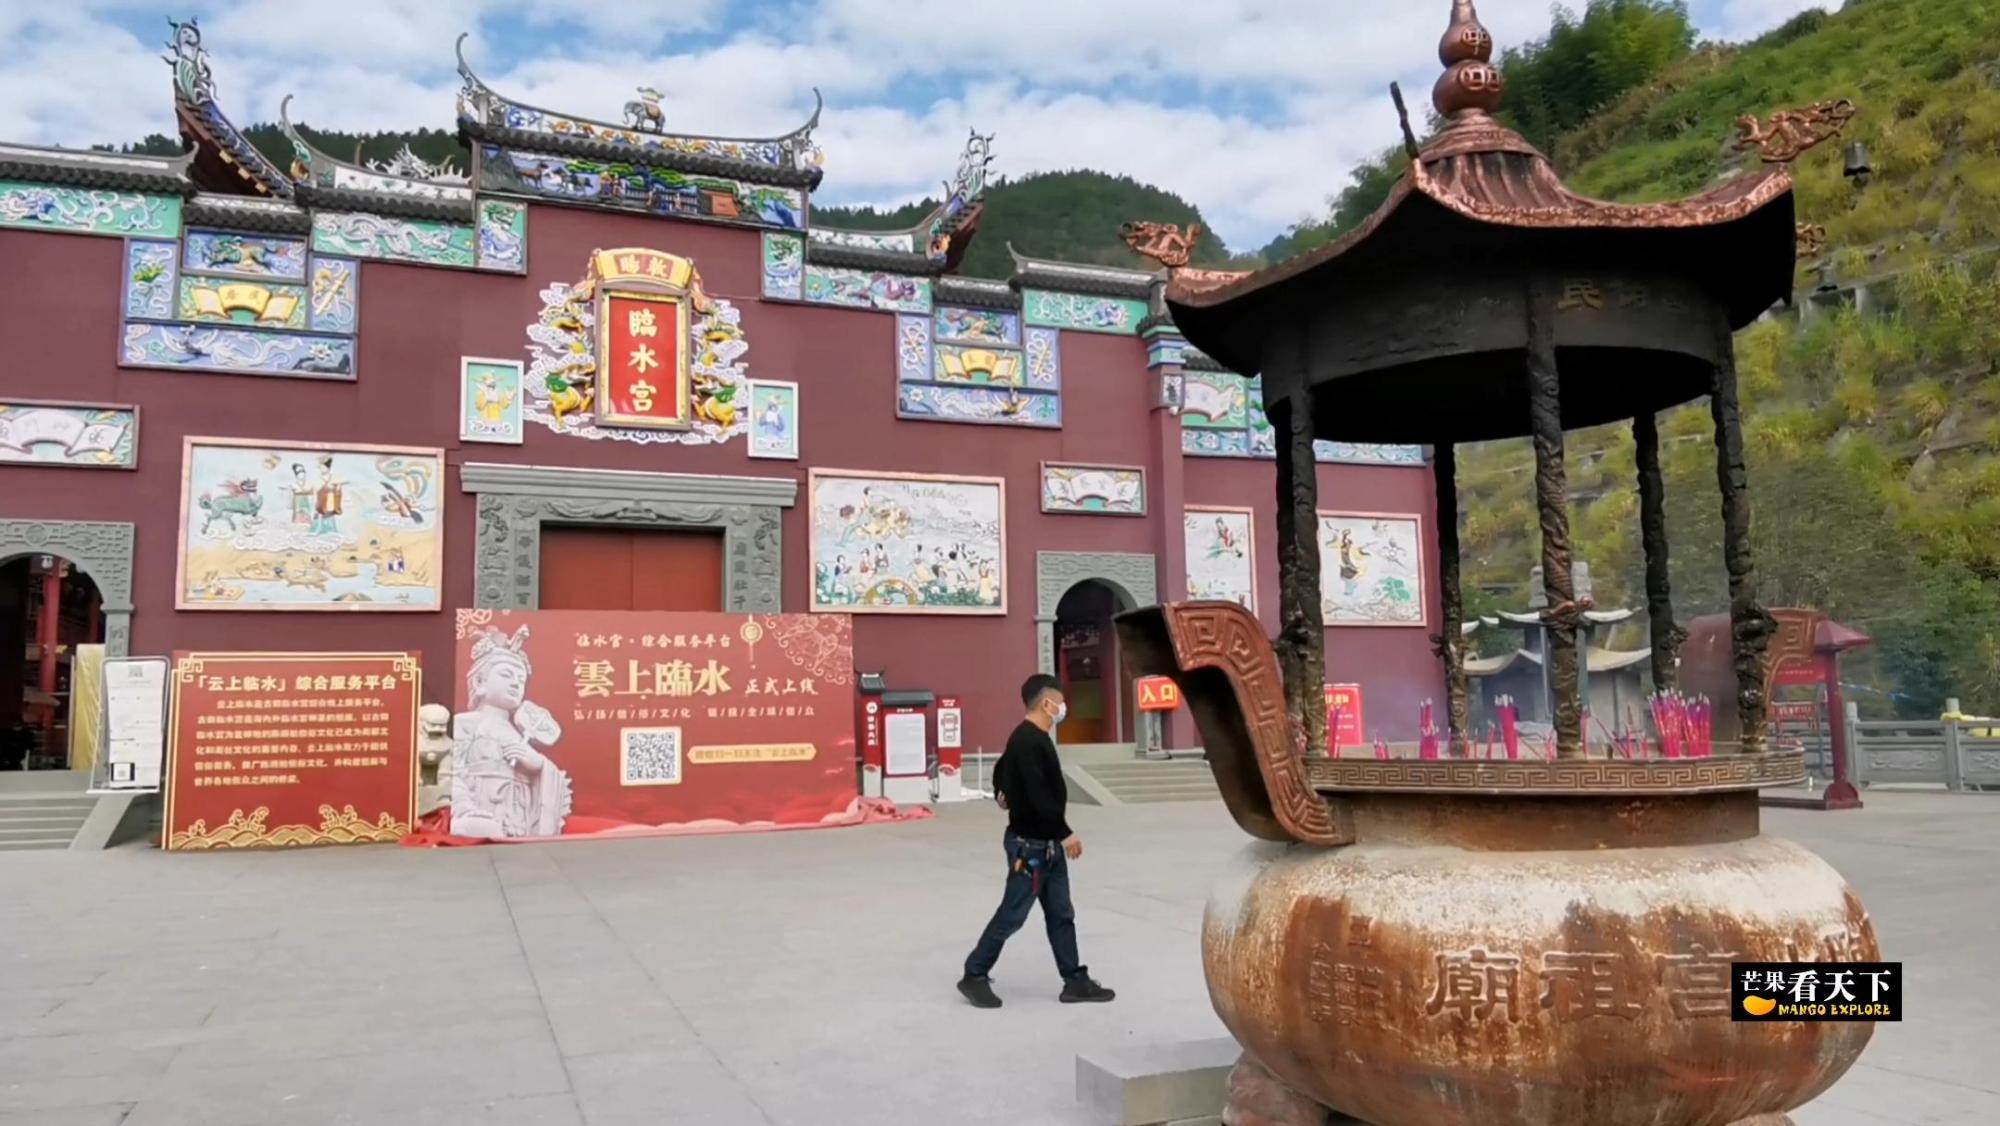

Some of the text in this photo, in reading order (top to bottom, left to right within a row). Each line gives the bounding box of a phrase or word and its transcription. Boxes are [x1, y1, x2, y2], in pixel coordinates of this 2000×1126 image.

[573, 659, 732, 698] 雲上臨水
[1141, 684, 1175, 704] 入口
